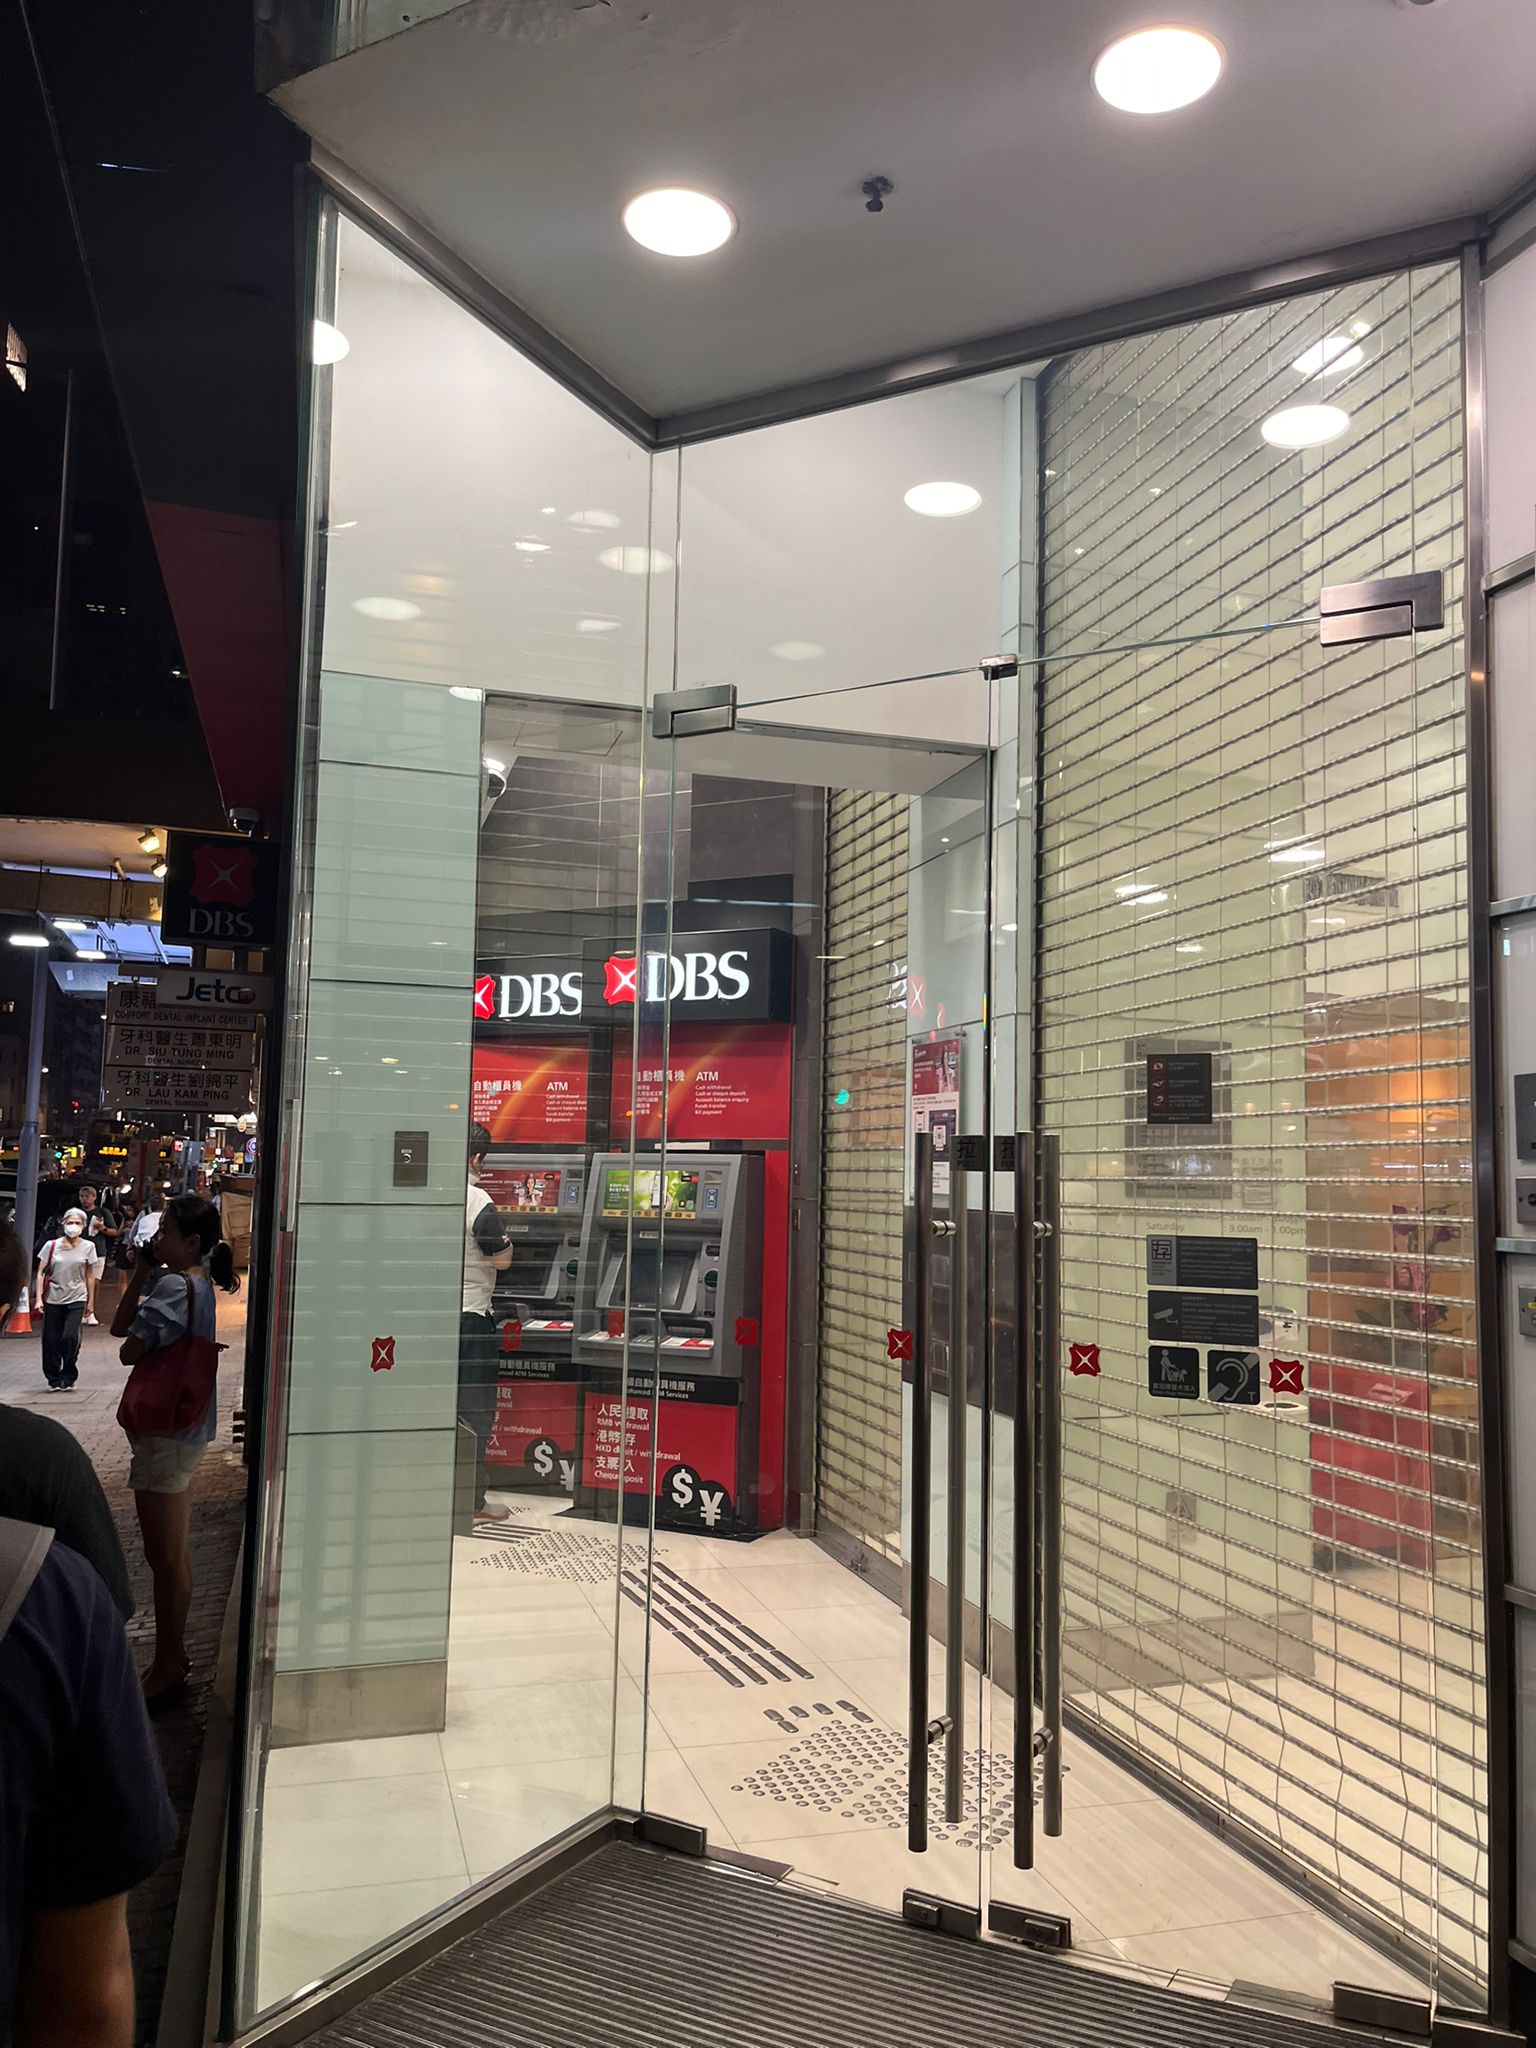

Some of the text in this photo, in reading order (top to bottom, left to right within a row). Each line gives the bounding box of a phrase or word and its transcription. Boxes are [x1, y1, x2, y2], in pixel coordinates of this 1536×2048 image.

[188, 908, 254, 937] DBS
[645, 951, 750, 1002] DBS
[498, 972, 582, 1018] DBS
[115, 1010, 248, 1024] COMFORT DENTAL IMPLANT CENTER
[125, 1046, 234, 1059] DR. SIU TUNG MING
[695, 1072, 718, 1081] ATM
[474, 1080, 522, 1092] 自動櫃員機
[546, 1081, 568, 1091] ATM
[125, 1088, 229, 1100] DR. LAU KAM PING
[958, 1138, 976, 1159] 拉
[1146, 1222, 1184, 1232] Saturday
[1229, 1224, 1262, 1233] 9.00am
[1248, 1392, 1256, 1401] T
[598, 1403, 648, 1420] 人民提取
[597, 1418, 612, 1426] RMB
[504, 1426, 542, 1435] withdrawal
[597, 1429, 636, 1446] 港幣存
[595, 1444, 611, 1452] HKD
[533, 1441, 553, 1476] $
[596, 1456, 635, 1472] 支票入
[594, 1470, 618, 1480] Chequ
[672, 1469, 724, 1526] $ ¥
